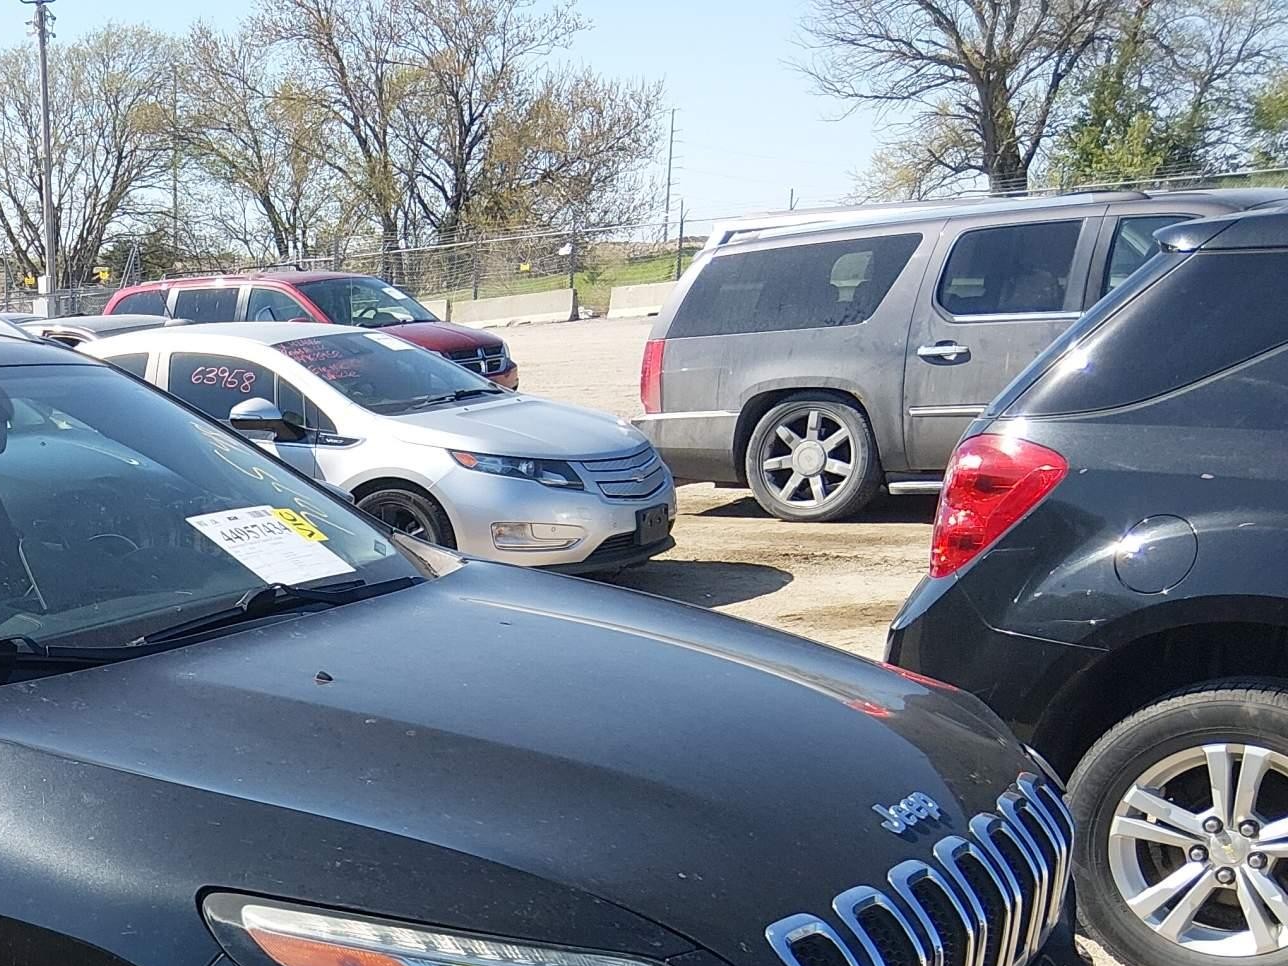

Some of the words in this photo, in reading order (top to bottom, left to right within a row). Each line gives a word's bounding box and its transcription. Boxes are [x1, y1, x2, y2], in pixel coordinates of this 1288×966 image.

[191, 366, 256, 393] 63958
[219, 520, 293, 543] 44957434
[871, 791, 941, 833] Jeep
